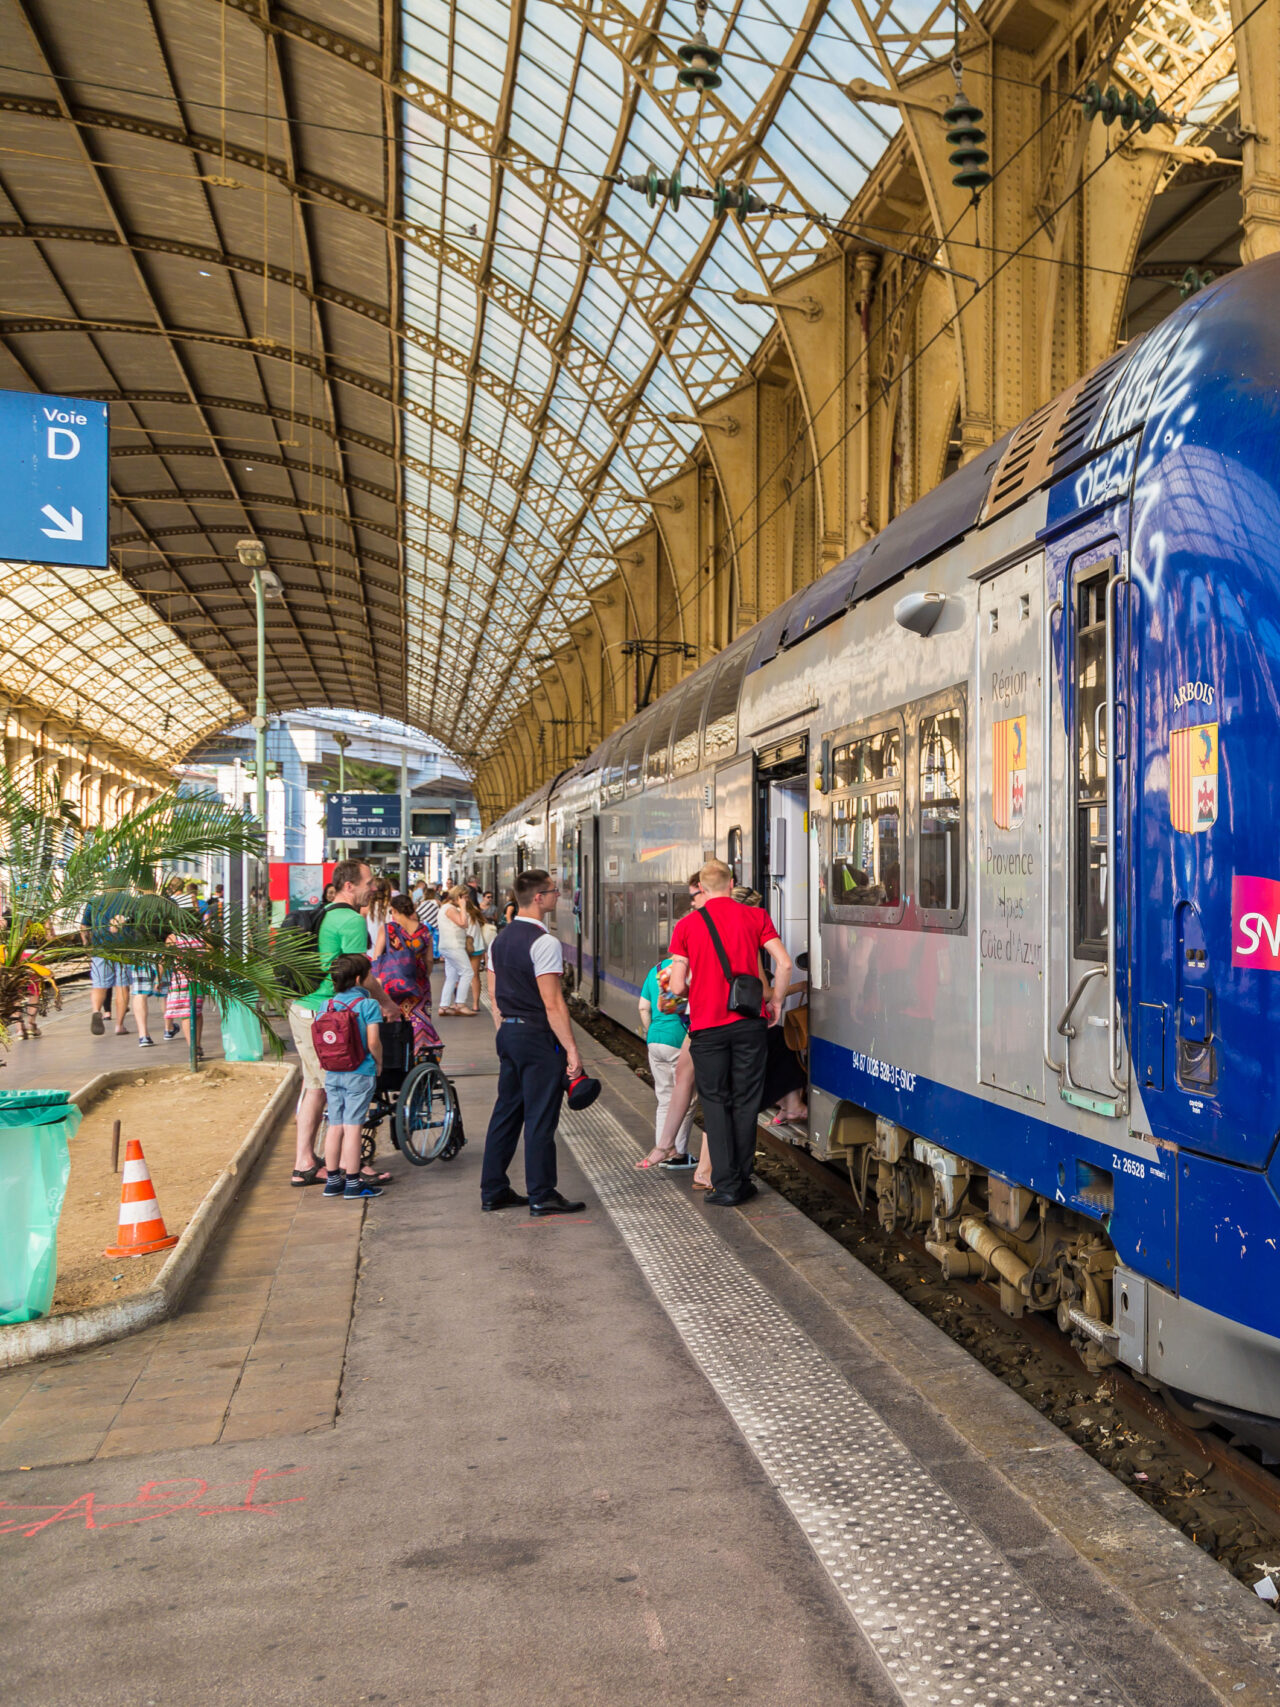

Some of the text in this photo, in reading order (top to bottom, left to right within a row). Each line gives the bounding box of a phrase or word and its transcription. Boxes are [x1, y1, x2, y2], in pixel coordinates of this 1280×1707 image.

[43, 408, 88, 425] Voie
[47, 427, 81, 460] D
[991, 665, 1027, 708] Région
[1173, 680, 1215, 713] ARBOIS
[408, 844, 421, 856] W
[409, 859, 416, 867] X
[986, 846, 1034, 876] Provence
[1112, 1153, 1145, 1179] Zx 26528
